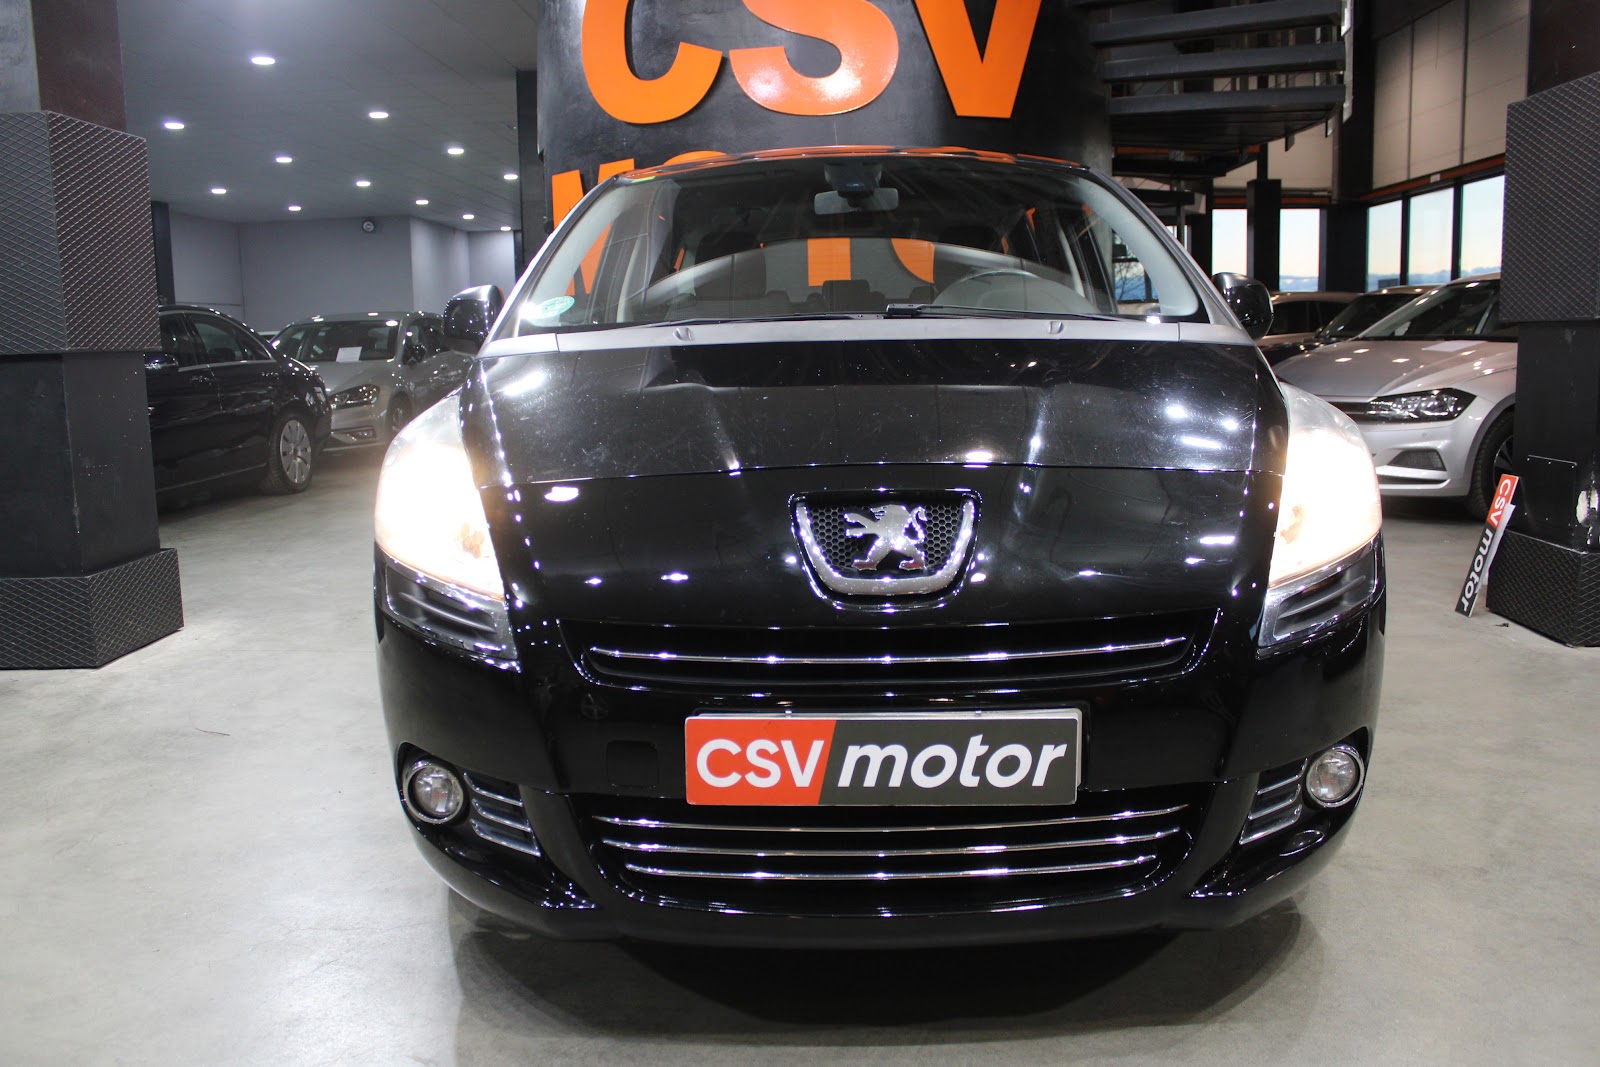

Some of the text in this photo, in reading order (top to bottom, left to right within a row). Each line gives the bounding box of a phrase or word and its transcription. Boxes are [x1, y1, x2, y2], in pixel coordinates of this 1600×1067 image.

[581, 0, 1043, 124] CSV
[1460, 478, 1512, 612] CSV motor
[697, 733, 1068, 788] CSV motor
